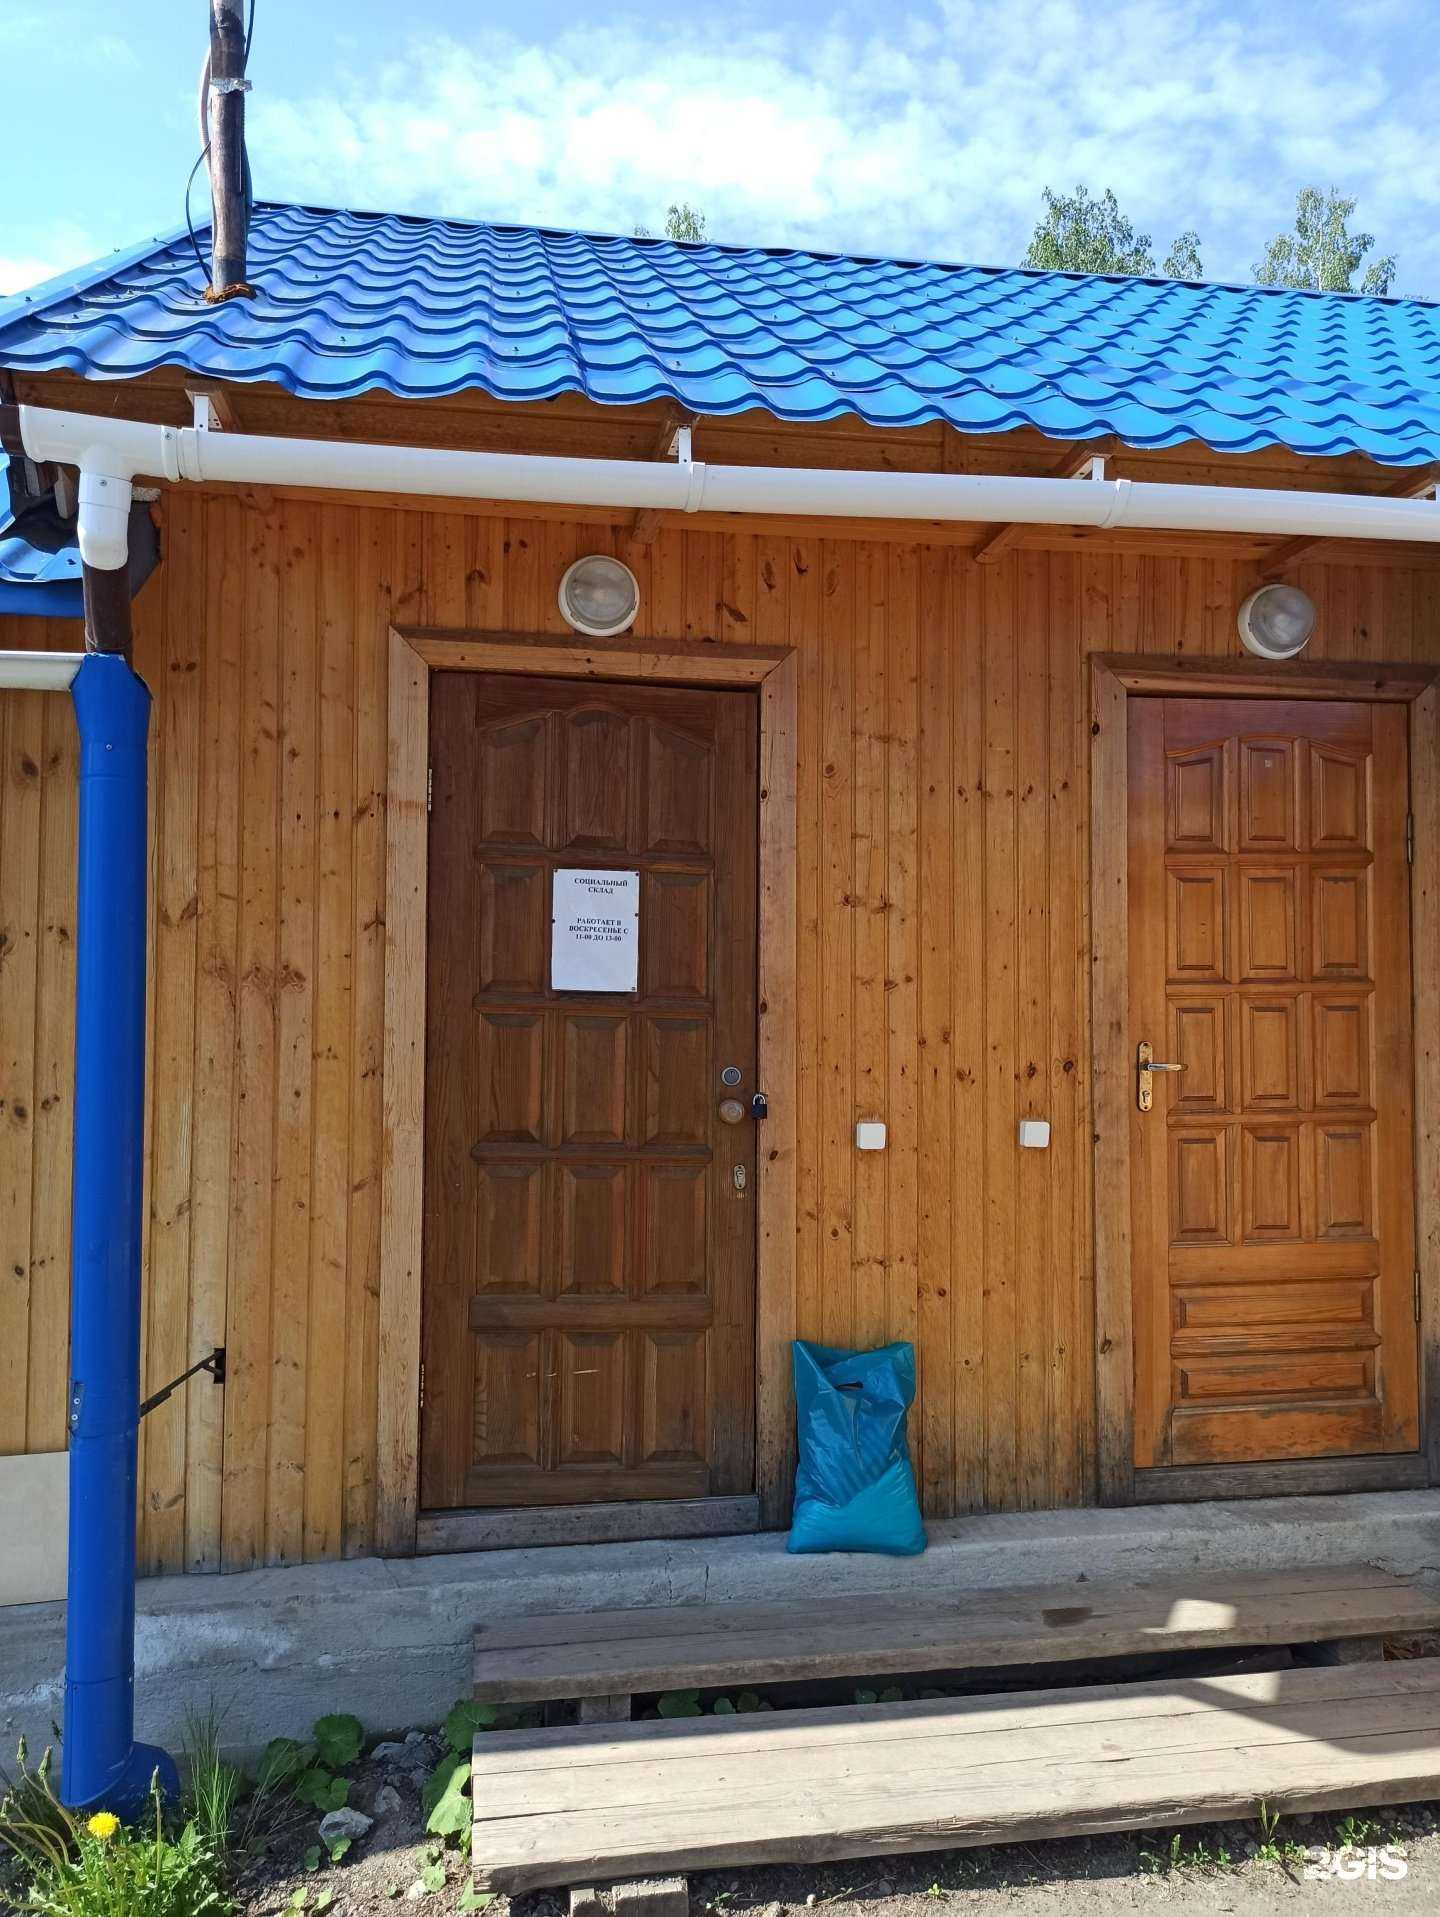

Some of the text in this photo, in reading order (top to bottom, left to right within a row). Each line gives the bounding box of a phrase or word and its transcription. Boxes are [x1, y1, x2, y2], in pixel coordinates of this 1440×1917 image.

[574, 878, 628, 887] СОЦИАЛЬНЫЙ
[577, 918, 615, 926] РАБОТАЕТ
[569, 925, 622, 934] ВОСКРЕСЕНЬЕ
